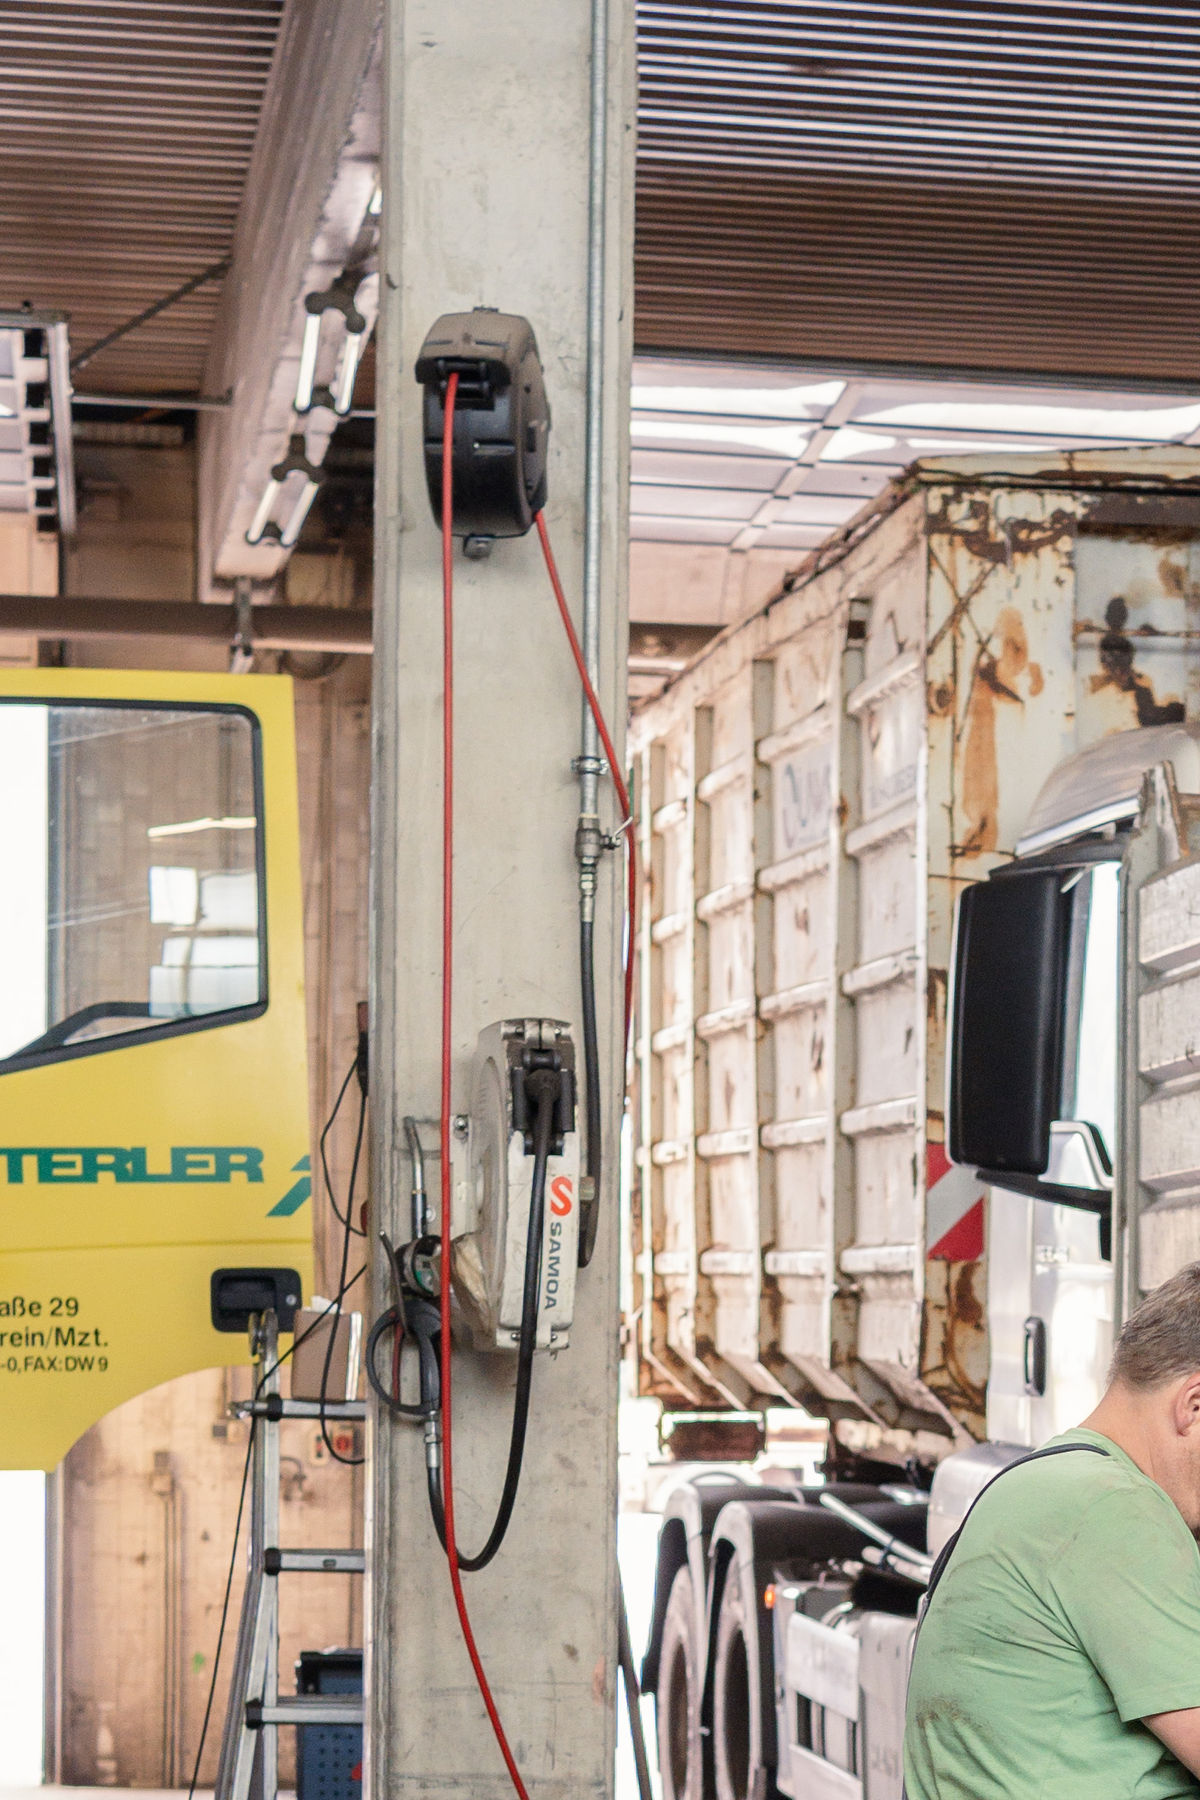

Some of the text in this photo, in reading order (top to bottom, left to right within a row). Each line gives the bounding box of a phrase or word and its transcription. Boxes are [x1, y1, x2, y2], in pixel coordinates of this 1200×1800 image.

[0, 1147, 264, 1184] TERLER
[544, 1221, 563, 1311] SAMOA
[49, 1297, 79, 1317] 29
